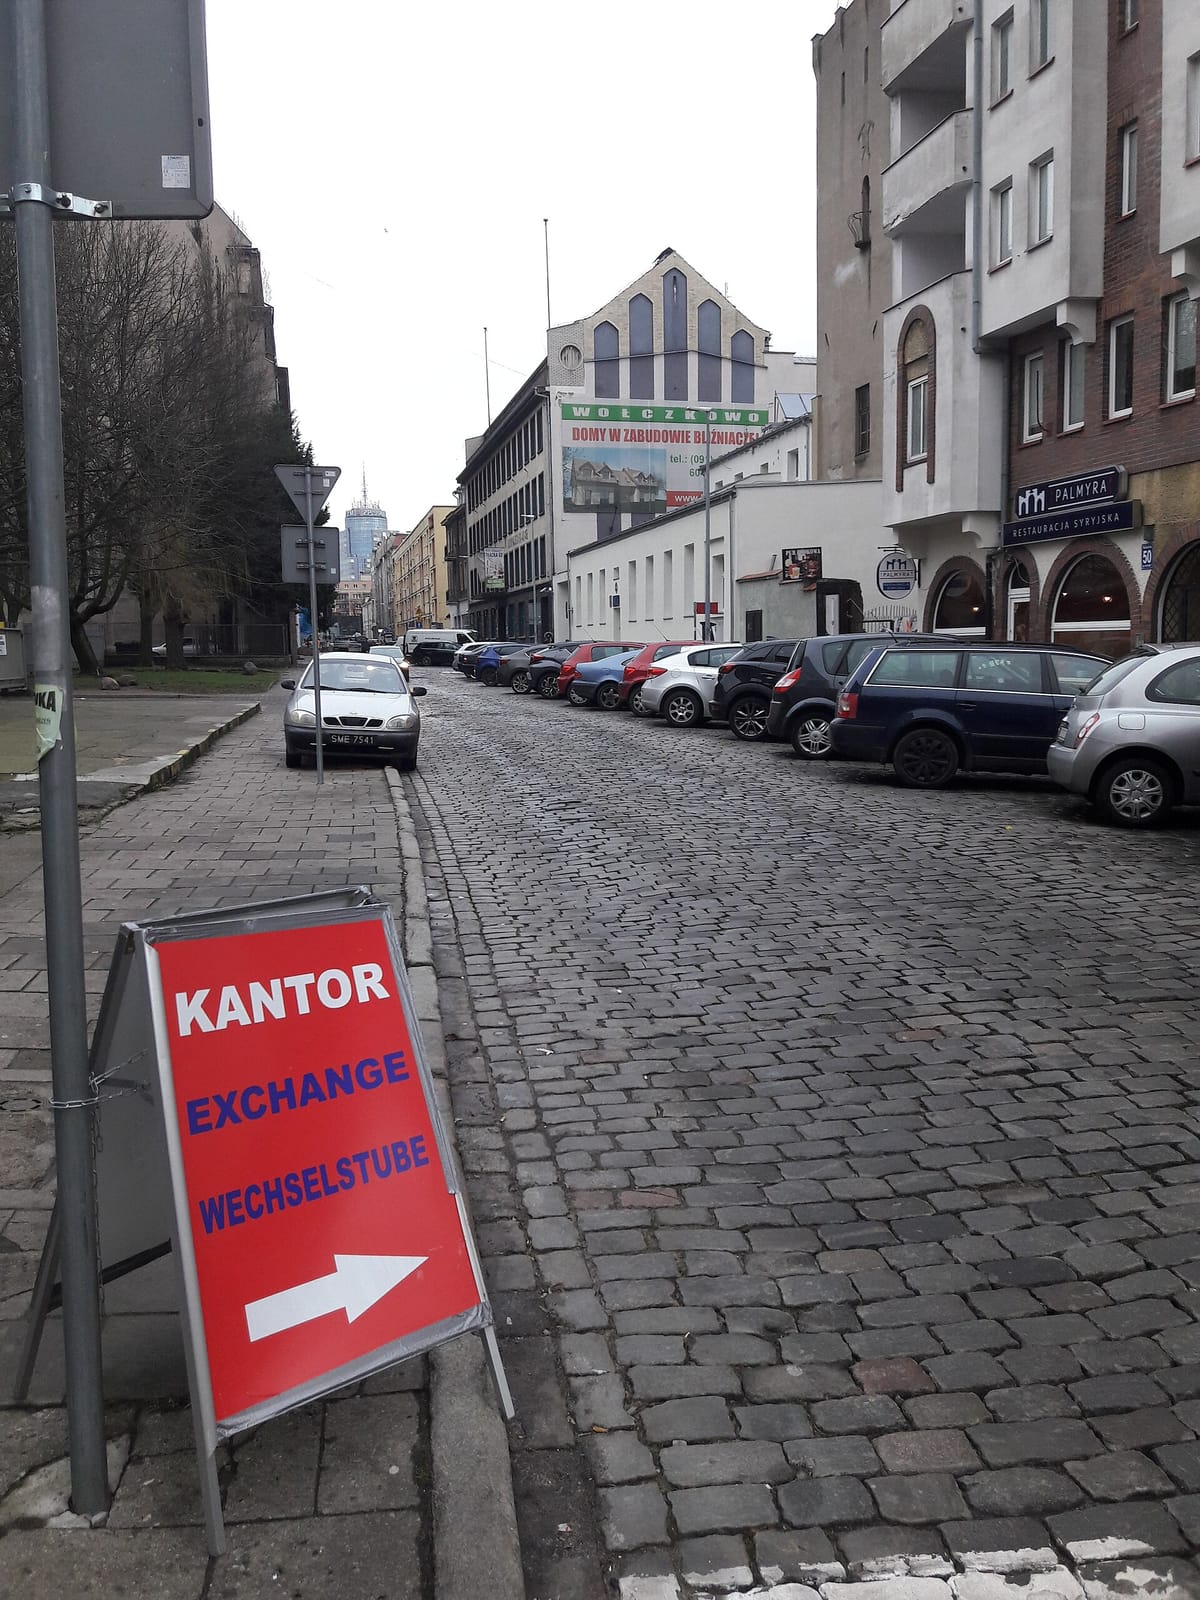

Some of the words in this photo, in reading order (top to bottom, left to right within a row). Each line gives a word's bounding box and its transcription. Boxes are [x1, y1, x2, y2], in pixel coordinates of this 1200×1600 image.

[572, 406, 760, 423] WOŁCZKOWO
[572, 427, 606, 442] DOMY
[609, 428, 622, 442] W
[623, 428, 691, 444] ZABUDOWIE
[694, 428, 759, 445] BLŹNIACZE
[670, 454, 688, 463] tel.:
[1055, 479, 1107, 502] PALMYRA
[1012, 520, 1070, 537] RESTAURACJA
[1074, 512, 1120, 528] SYRYJSKA
[1142, 550, 1152, 564] 50
[331, 735, 350, 744] SME
[353, 735, 374, 744] 7541
[175, 962, 391, 1037] KANTOR
[185, 1051, 410, 1136] EXCHANGE
[199, 1134, 430, 1235] WECHSELSTUBE
